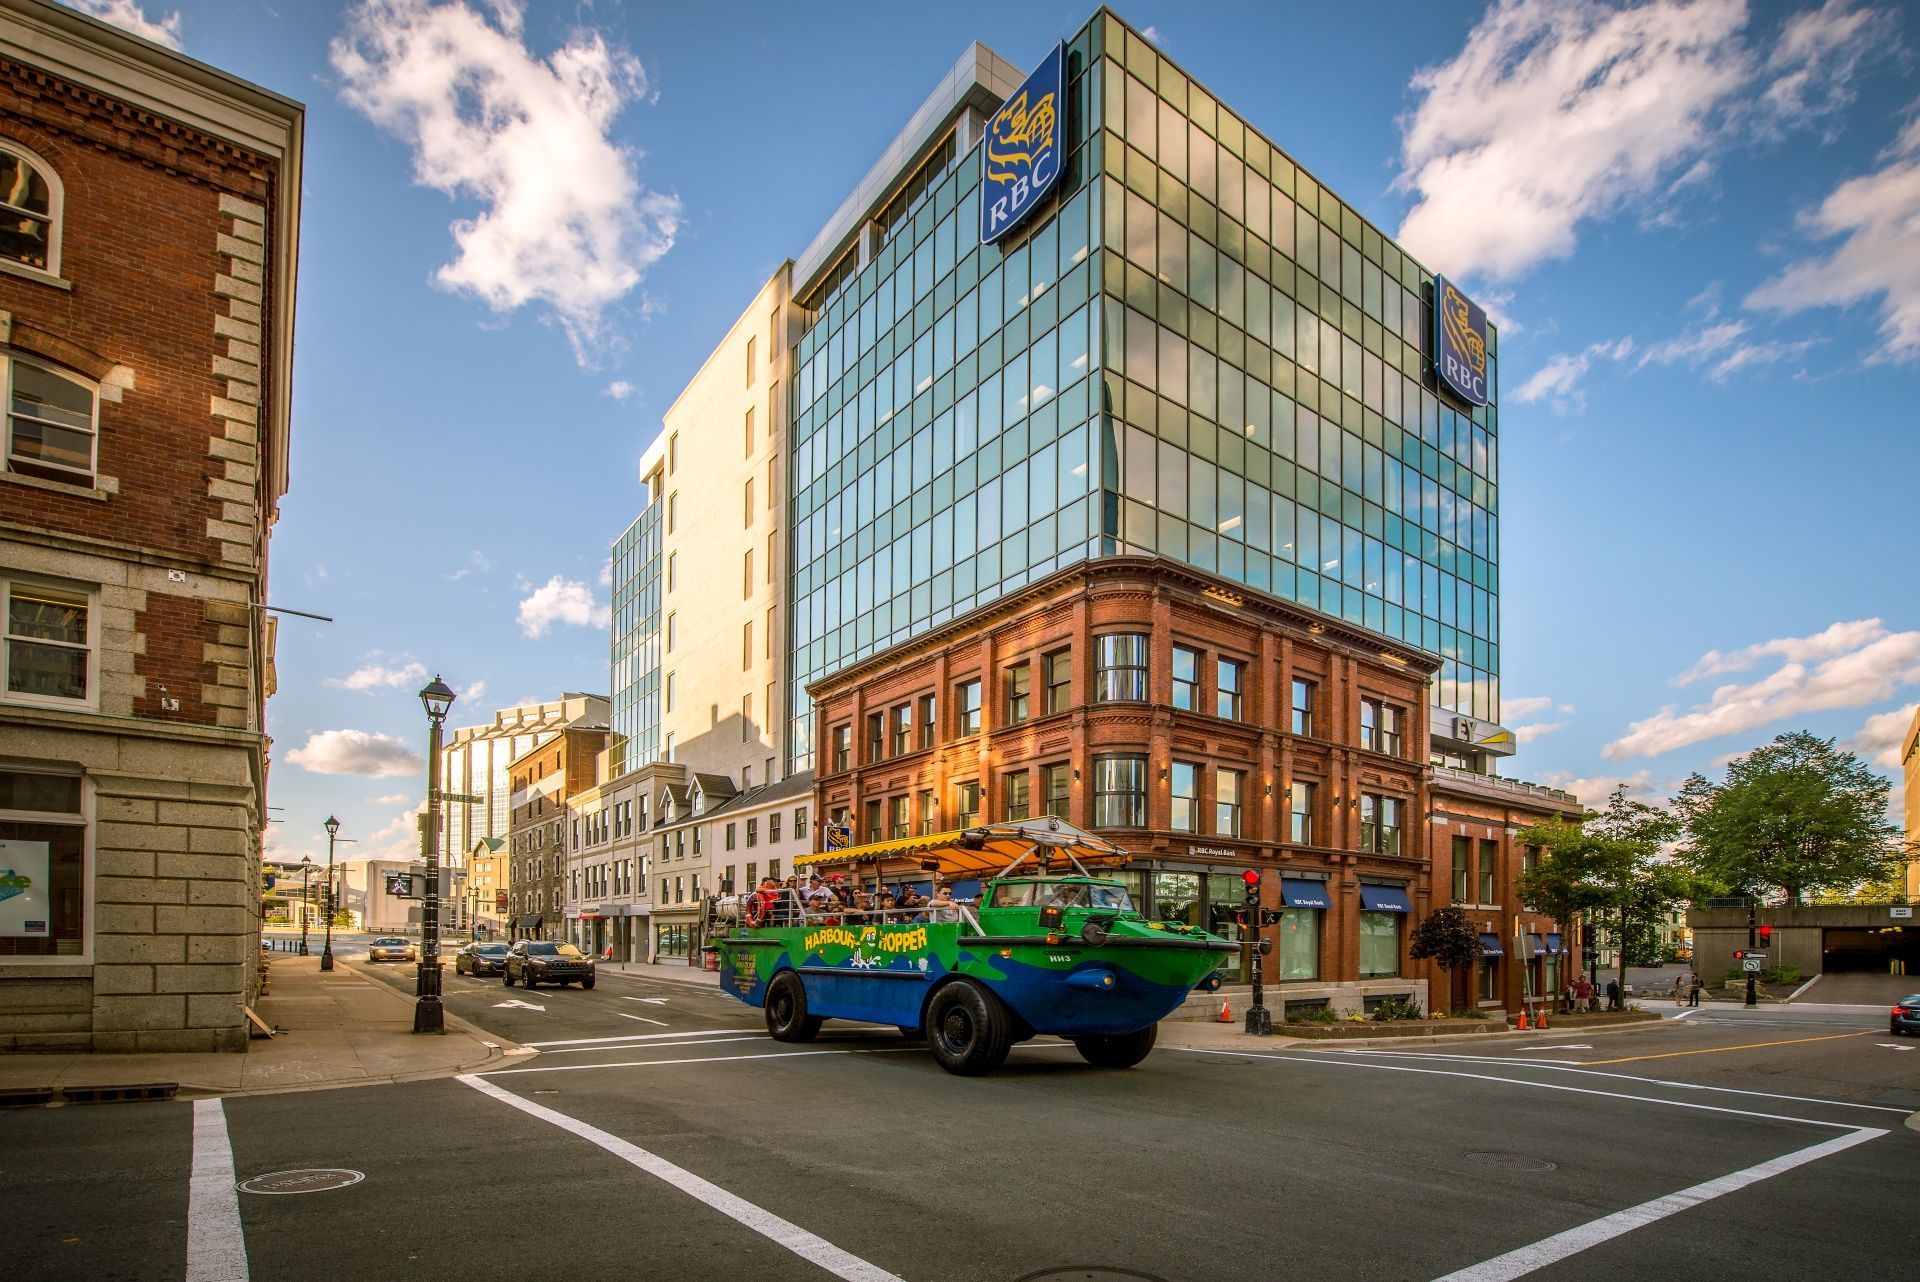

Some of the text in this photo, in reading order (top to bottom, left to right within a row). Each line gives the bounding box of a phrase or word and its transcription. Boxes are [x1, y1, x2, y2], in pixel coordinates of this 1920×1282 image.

[990, 151, 1051, 232] RBC
[1446, 354, 1484, 399] RBC
[1453, 717, 1477, 742] EY
[445, 794, 470, 803] DUKE
[1208, 848, 1223, 856] Royal
[1223, 849, 1236, 857] Bank
[805, 927, 927, 952] HARBOUR HOPPER
[1049, 955, 1072, 963] HH3
